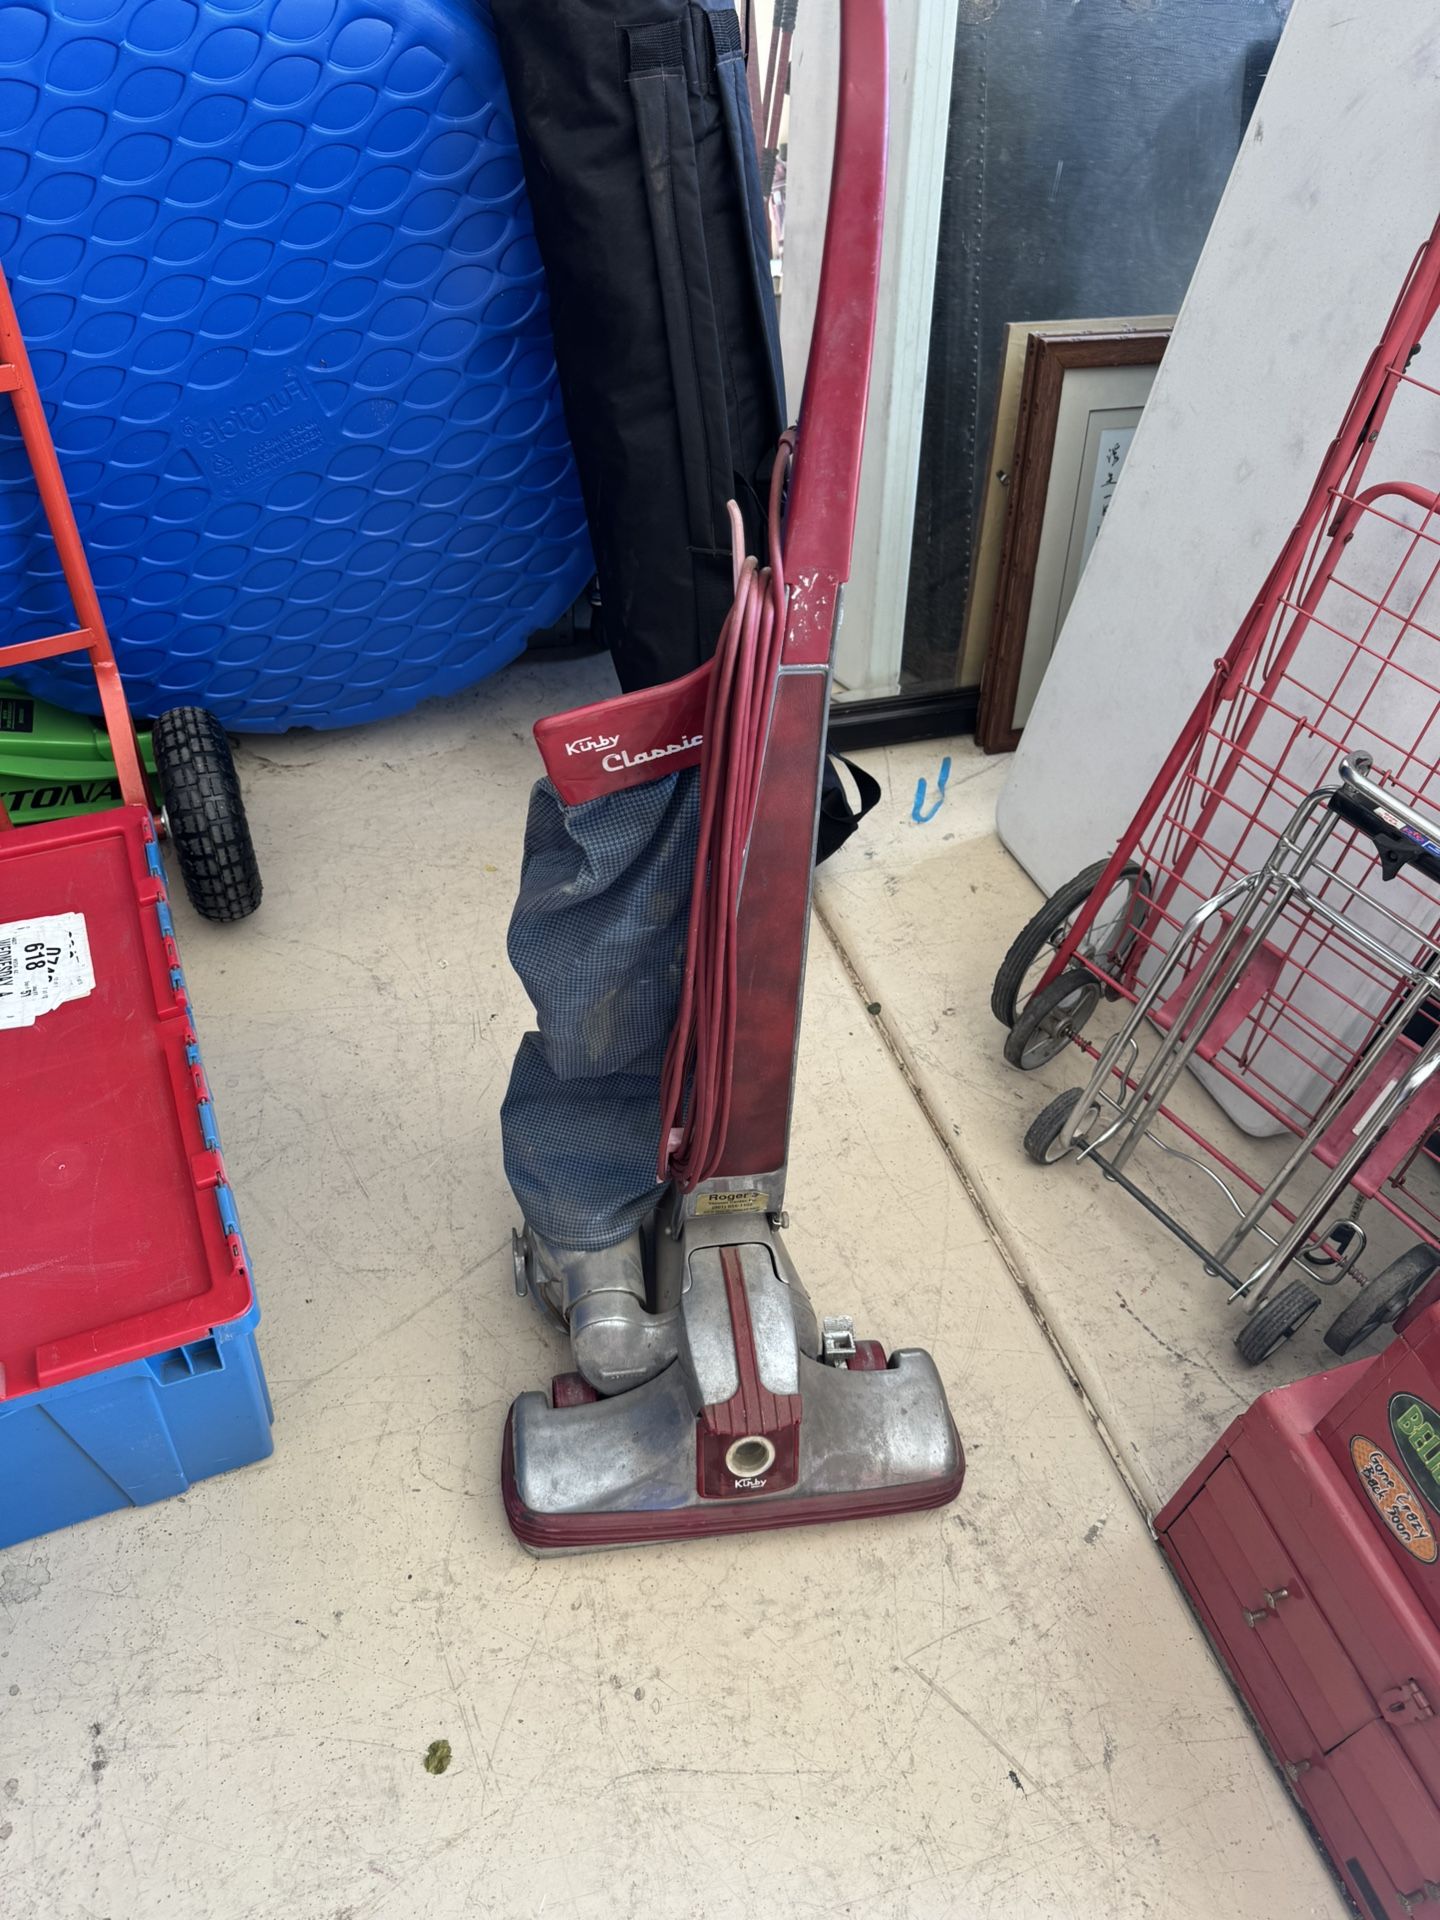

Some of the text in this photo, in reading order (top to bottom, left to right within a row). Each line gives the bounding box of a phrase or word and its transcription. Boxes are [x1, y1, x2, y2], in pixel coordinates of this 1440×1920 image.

[565, 734, 620, 756] Kirby
[602, 735, 703, 772] Classic
[24, 943, 46, 970] 618
[735, 1478, 767, 1488] Kirby
[1369, 1452, 1430, 1539] Gone Crazy
[1361, 1464, 1412, 1541] Back Soon
